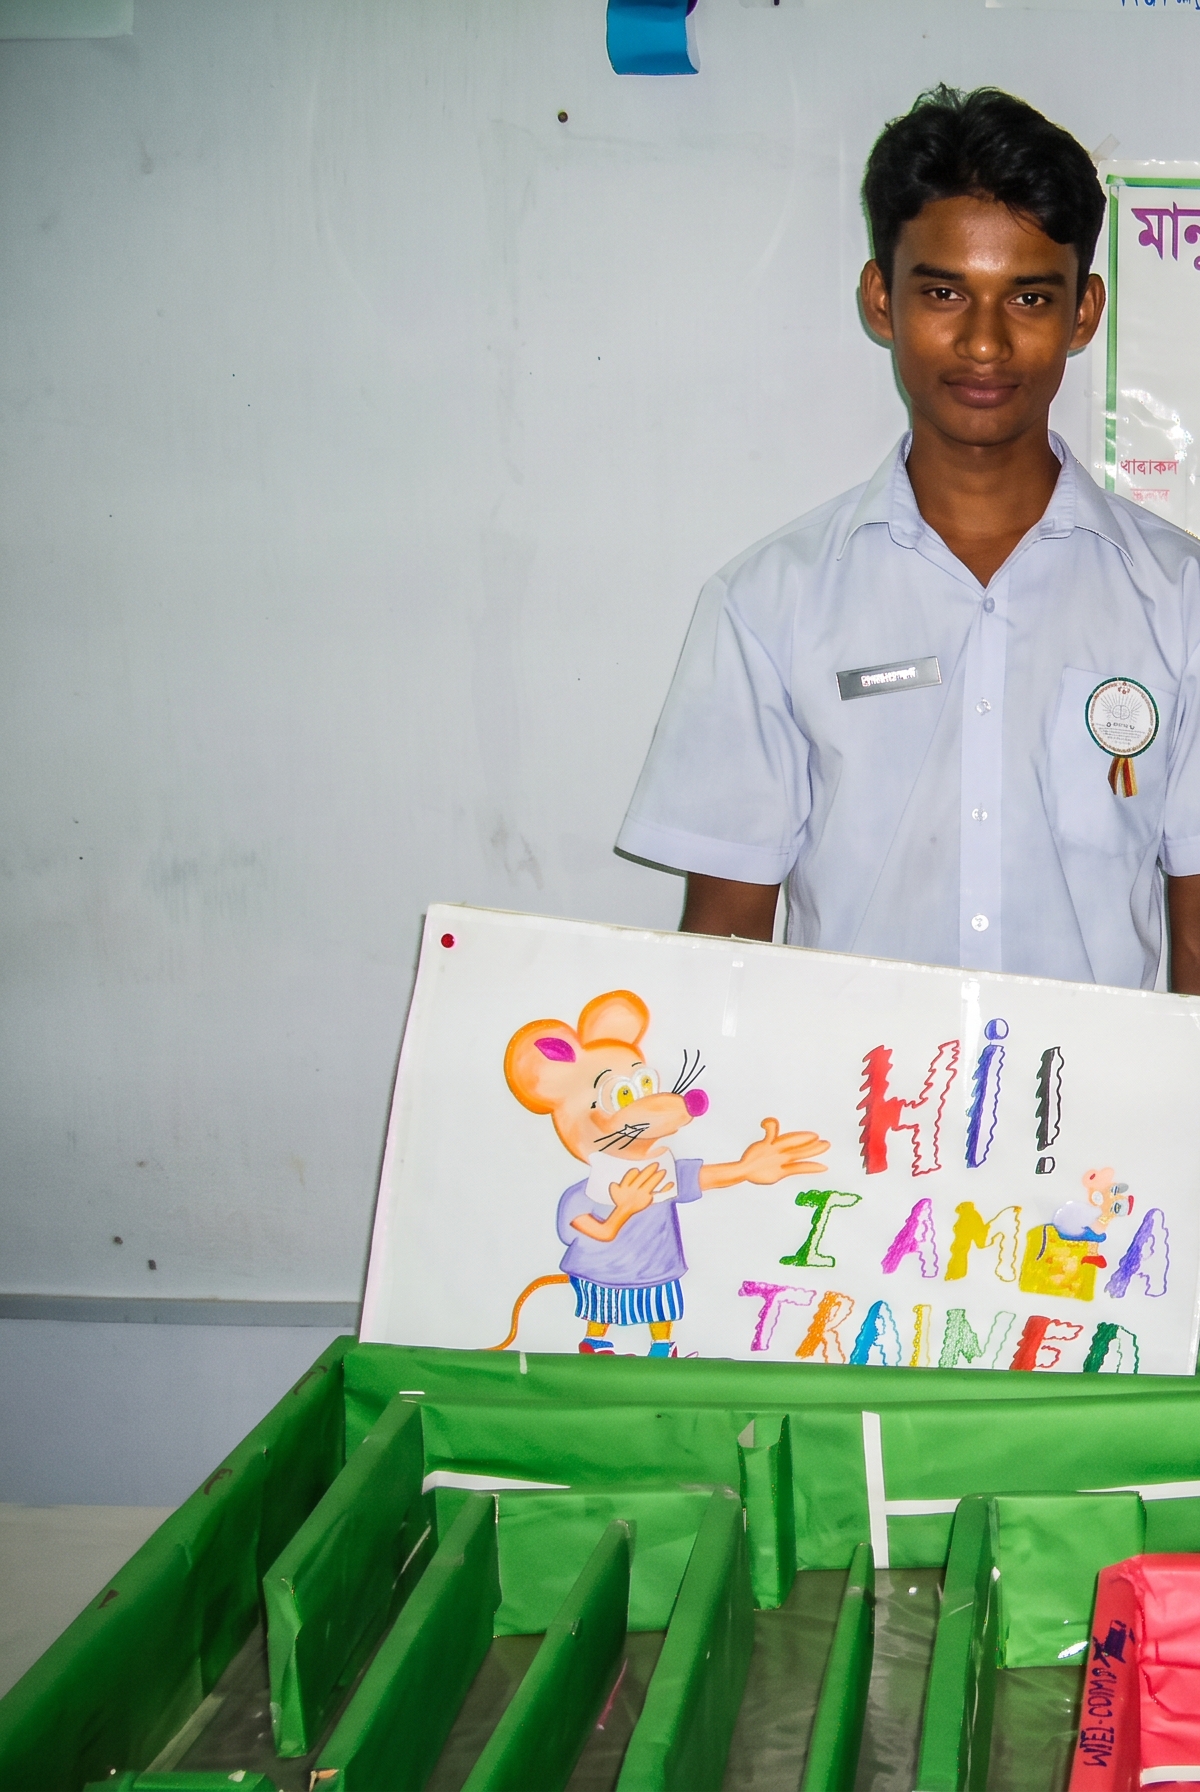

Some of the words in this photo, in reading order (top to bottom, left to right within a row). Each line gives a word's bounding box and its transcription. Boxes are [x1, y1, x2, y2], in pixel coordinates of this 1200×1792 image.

[779, 1189, 862, 1268] I
[881, 1198, 1022, 1282] AM
[1104, 1208, 1170, 1298] A
